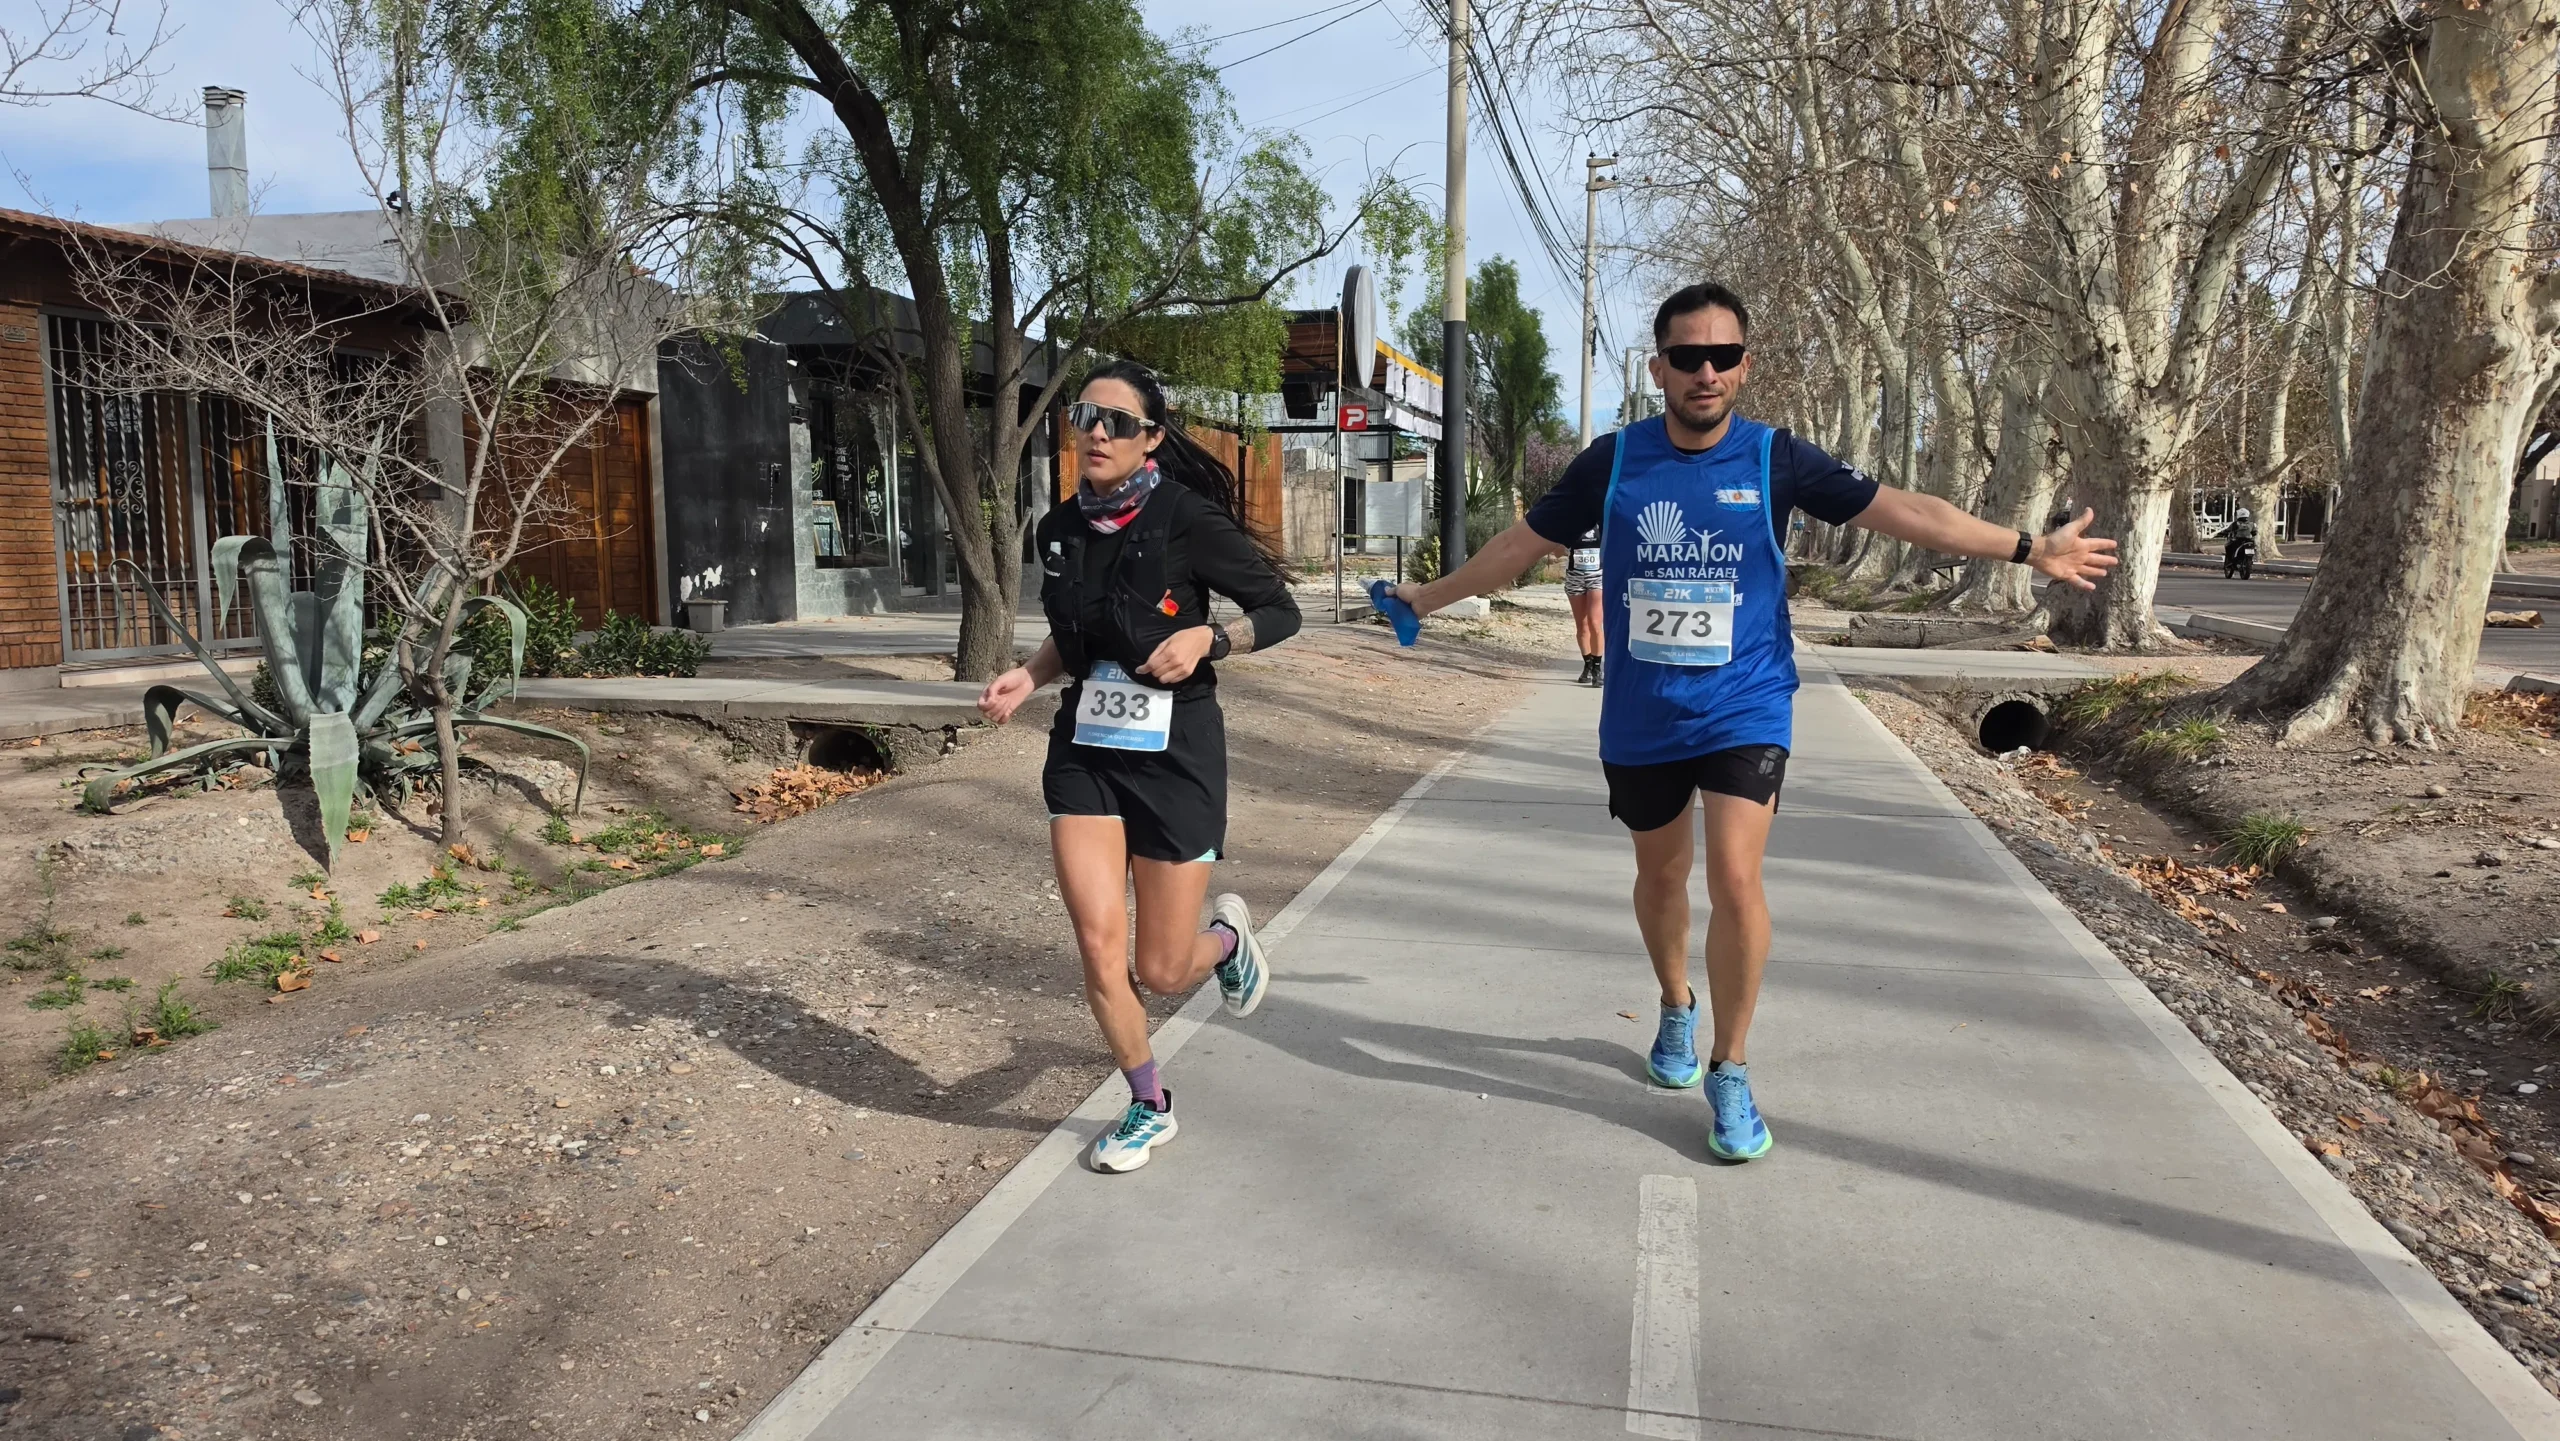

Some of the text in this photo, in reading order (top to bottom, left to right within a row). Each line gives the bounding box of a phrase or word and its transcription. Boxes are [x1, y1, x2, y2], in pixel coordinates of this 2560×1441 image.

[1578, 555, 1596, 564] 360
[1637, 539, 1743, 564] MARATON
[1644, 567, 1739, 579] DE SAN RAFAEL
[1663, 588, 1692, 600] 21K
[1646, 608, 1712, 638] 273
[1090, 689, 1150, 721] 333
